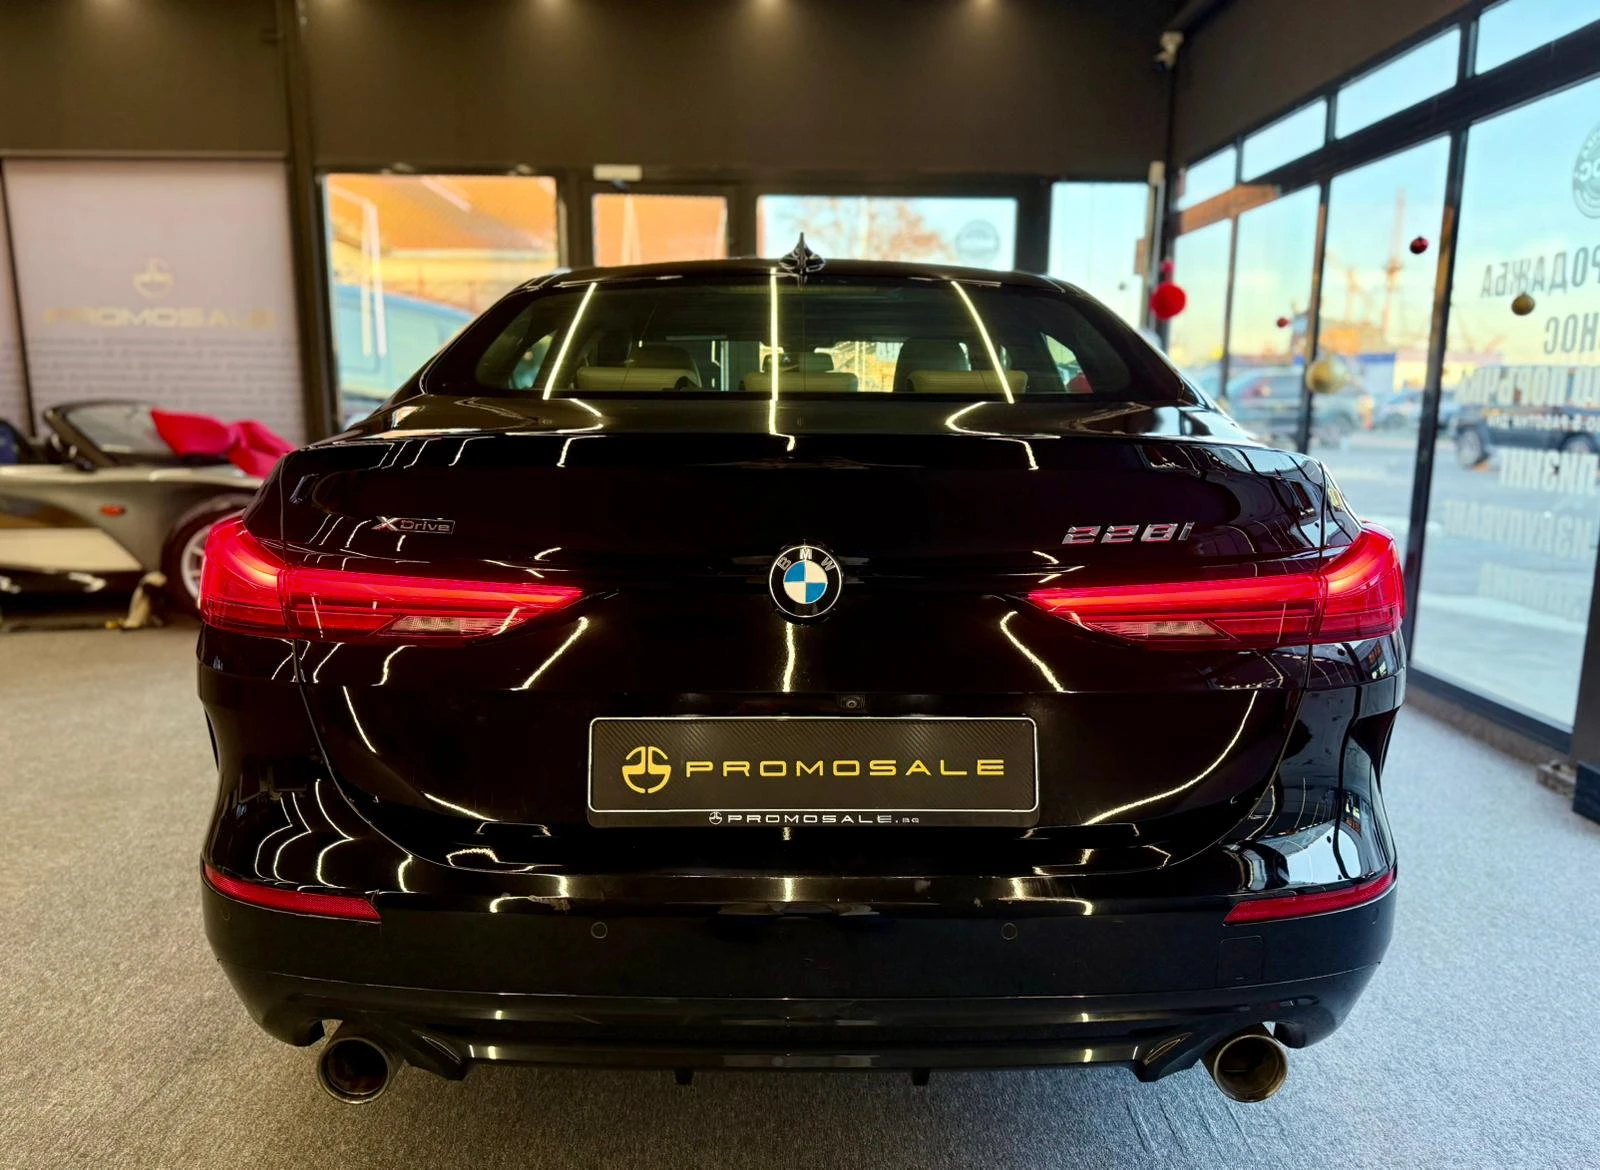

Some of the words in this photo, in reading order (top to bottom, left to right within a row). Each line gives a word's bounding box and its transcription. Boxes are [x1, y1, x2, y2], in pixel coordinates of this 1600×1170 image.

[1062, 522, 1195, 545] 228i
[776, 548, 836, 572] BMW
[685, 758, 1005, 778] PROMOSALE
